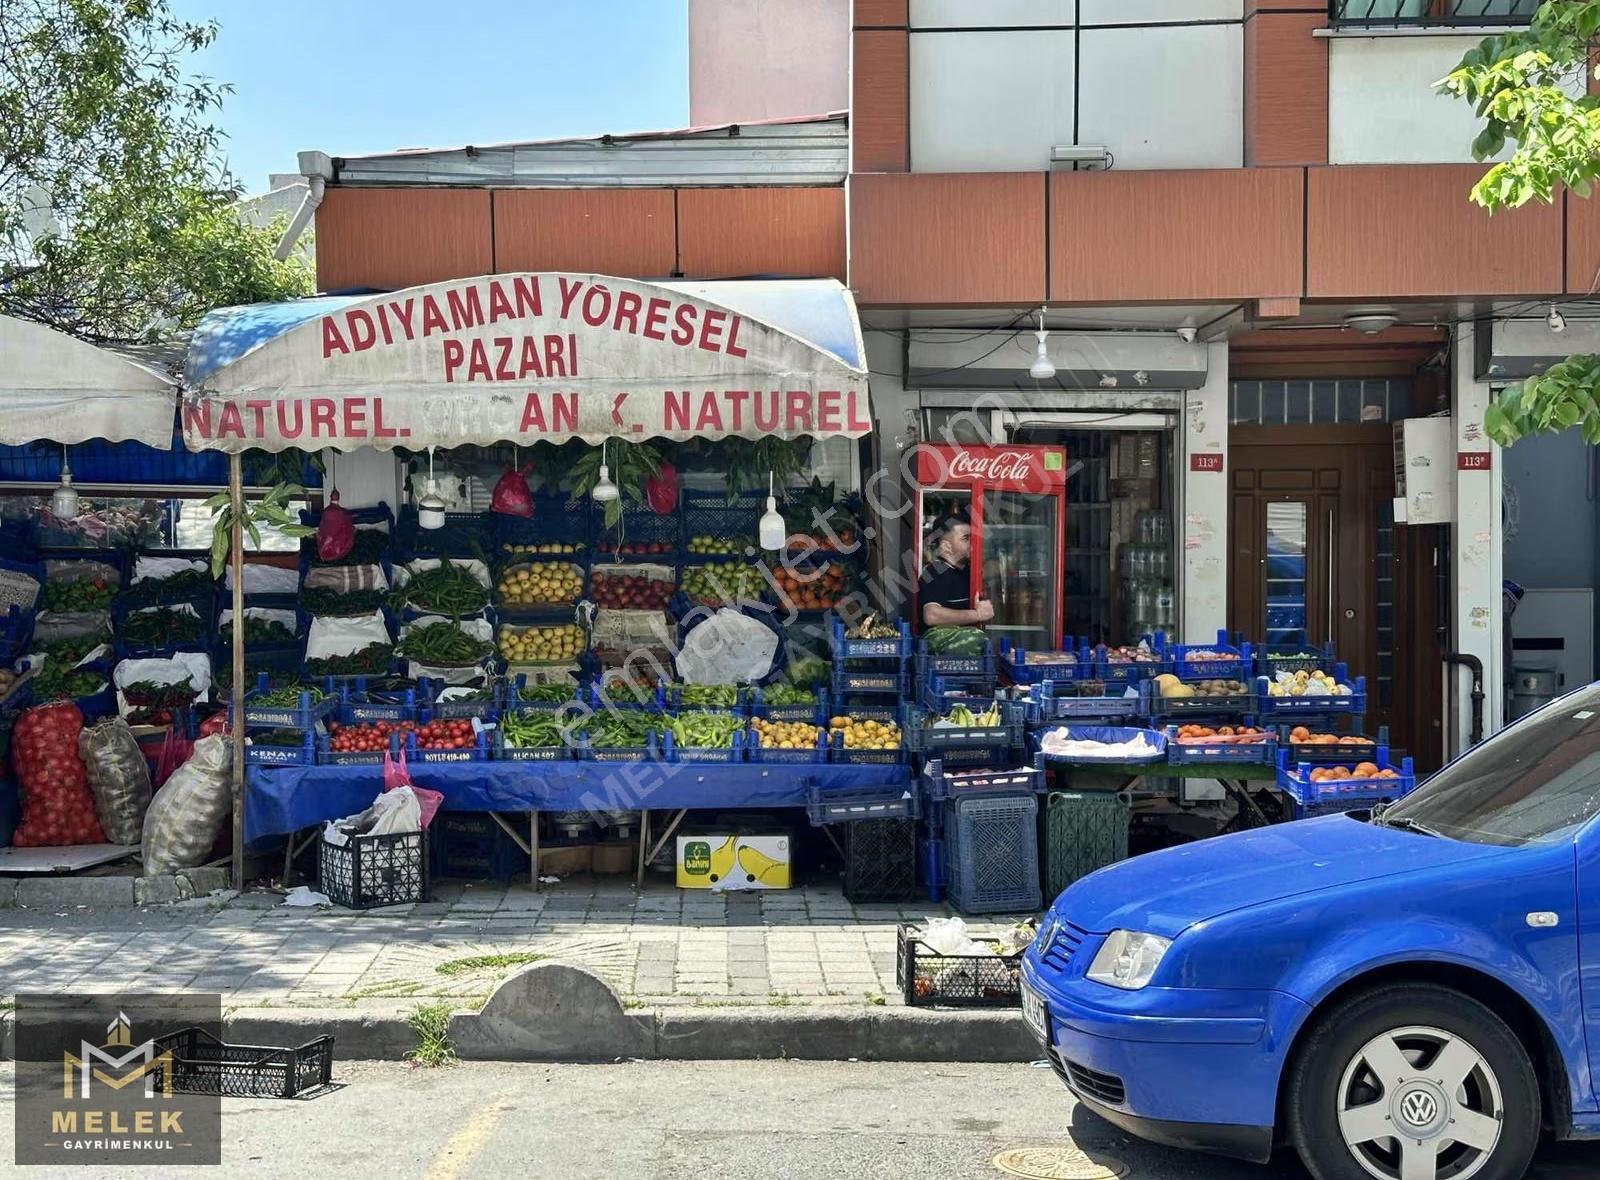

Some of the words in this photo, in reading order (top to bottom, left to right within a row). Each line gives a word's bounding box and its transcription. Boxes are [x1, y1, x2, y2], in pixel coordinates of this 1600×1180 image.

[322, 275, 543, 359] ADIYAMAN
[557, 276, 749, 359] YÖRESEL
[443, 333, 578, 383] PAZARI
[663, 390, 871, 432] NATUREL
[950, 450, 1034, 480] Coca-Cola
